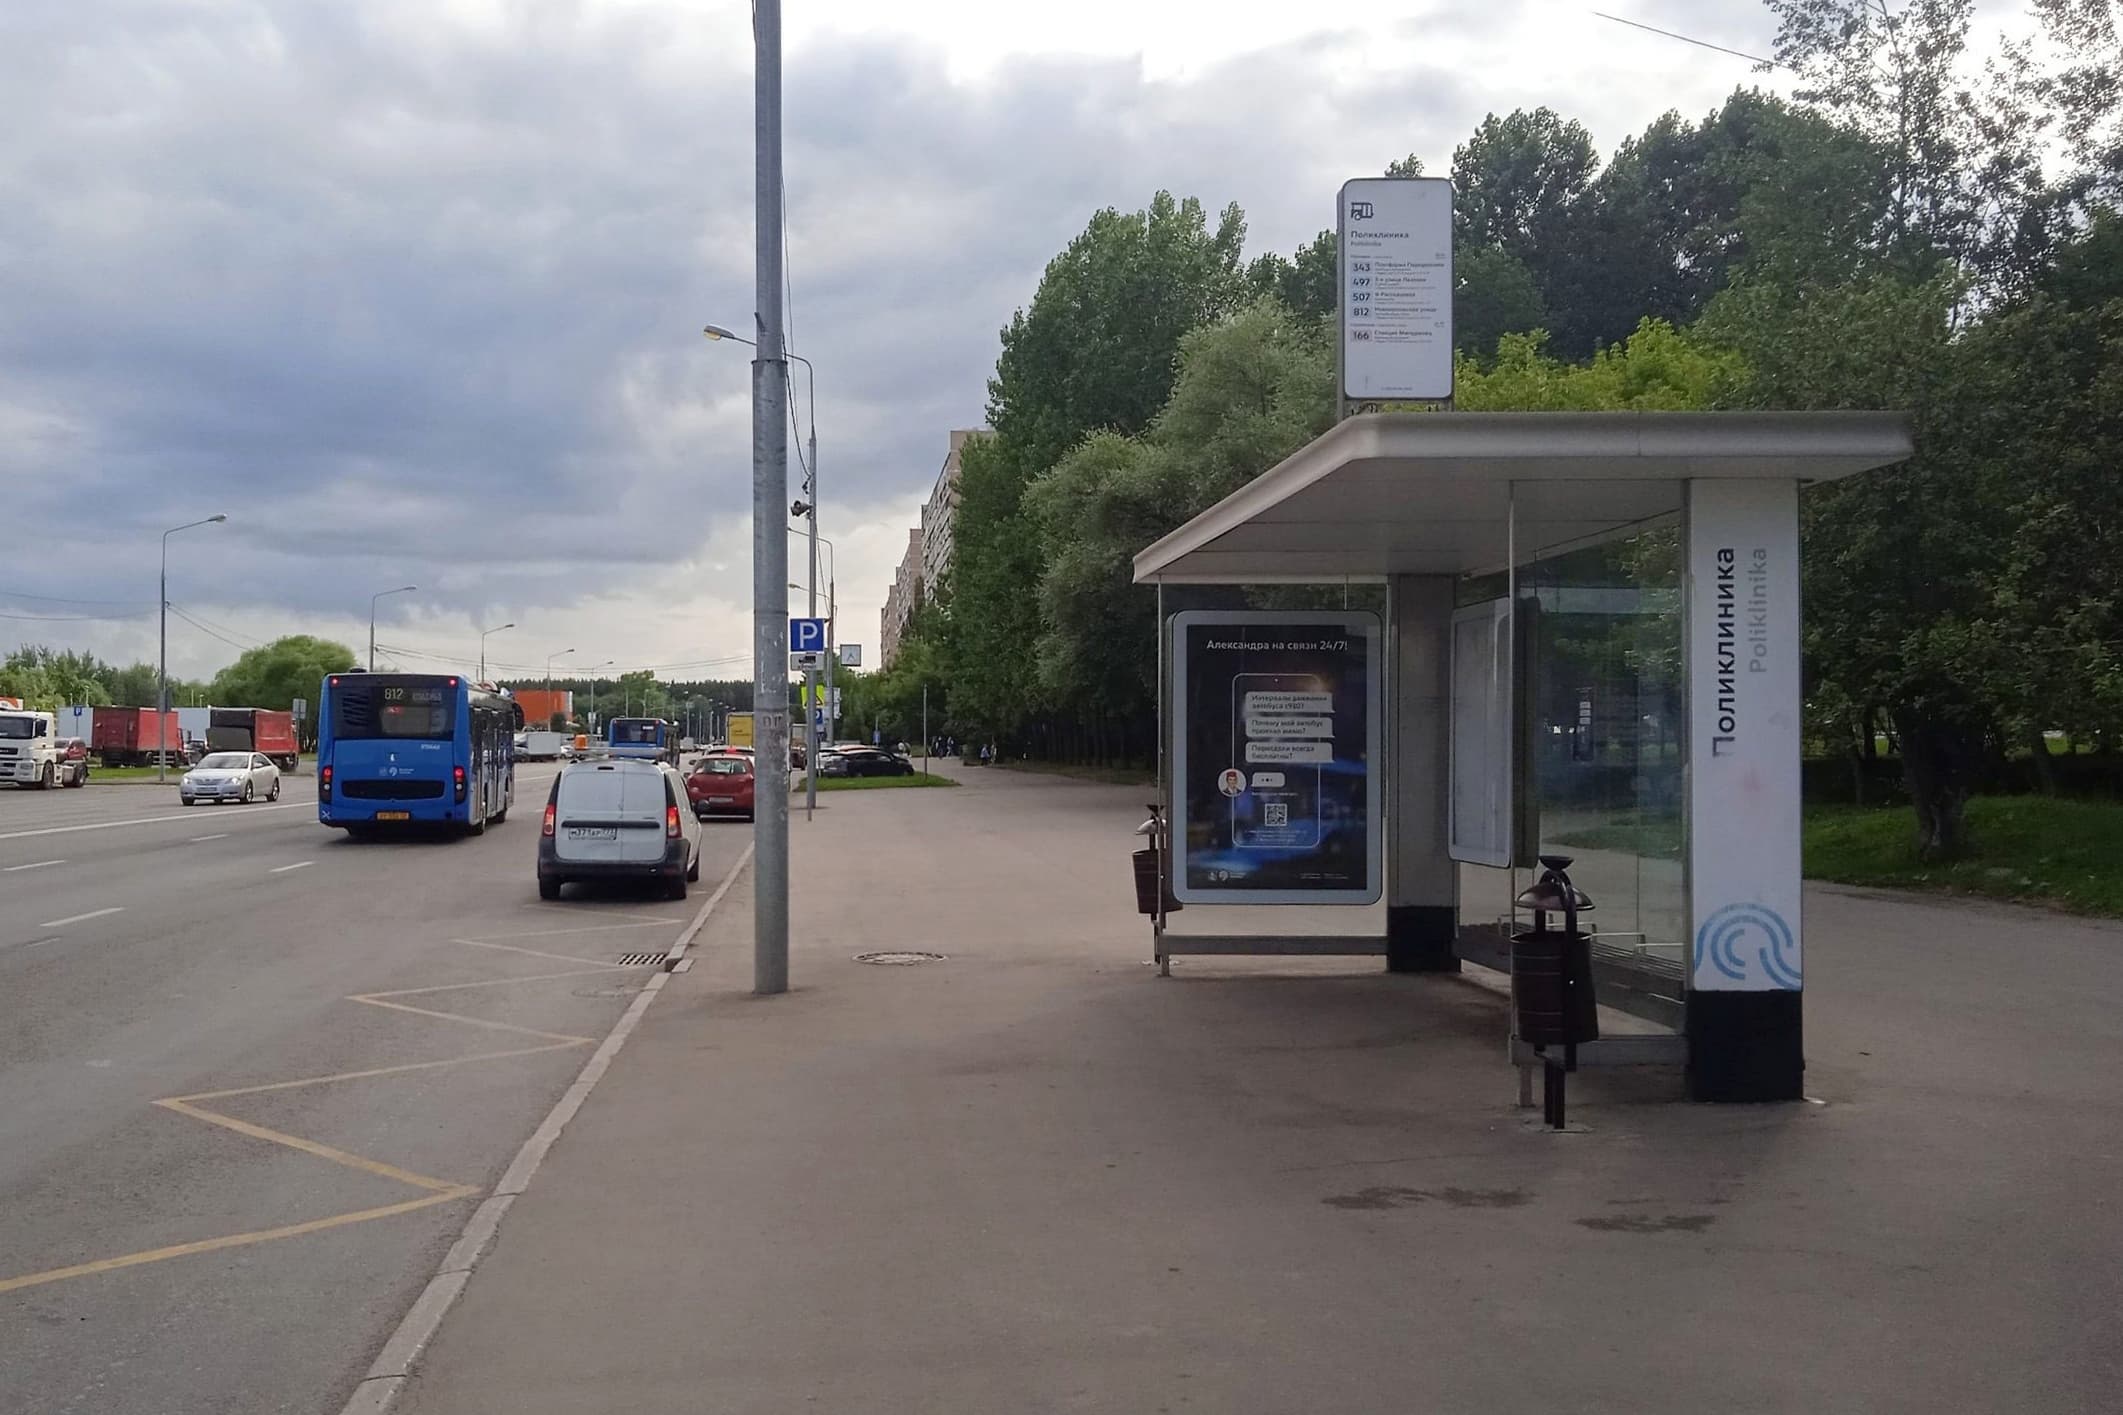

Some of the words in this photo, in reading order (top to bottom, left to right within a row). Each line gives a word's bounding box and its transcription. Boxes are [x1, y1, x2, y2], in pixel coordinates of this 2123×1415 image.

[1351, 230, 1409, 239] Поликлиника
[1353, 263, 1370, 272] 343
[1353, 278, 1370, 286] 497
[1352, 293, 1371, 301] 507
[1353, 307, 1369, 316] 812
[1353, 331, 1369, 340] 166
[1748, 548, 1768, 673] Poliklinika
[799, 622, 818, 649] P
[1206, 639, 1270, 651] Александра
[1319, 640, 1348, 650] 24/7!
[1712, 548, 1736, 757] Поликлиника
[384, 688, 403, 700] 812
